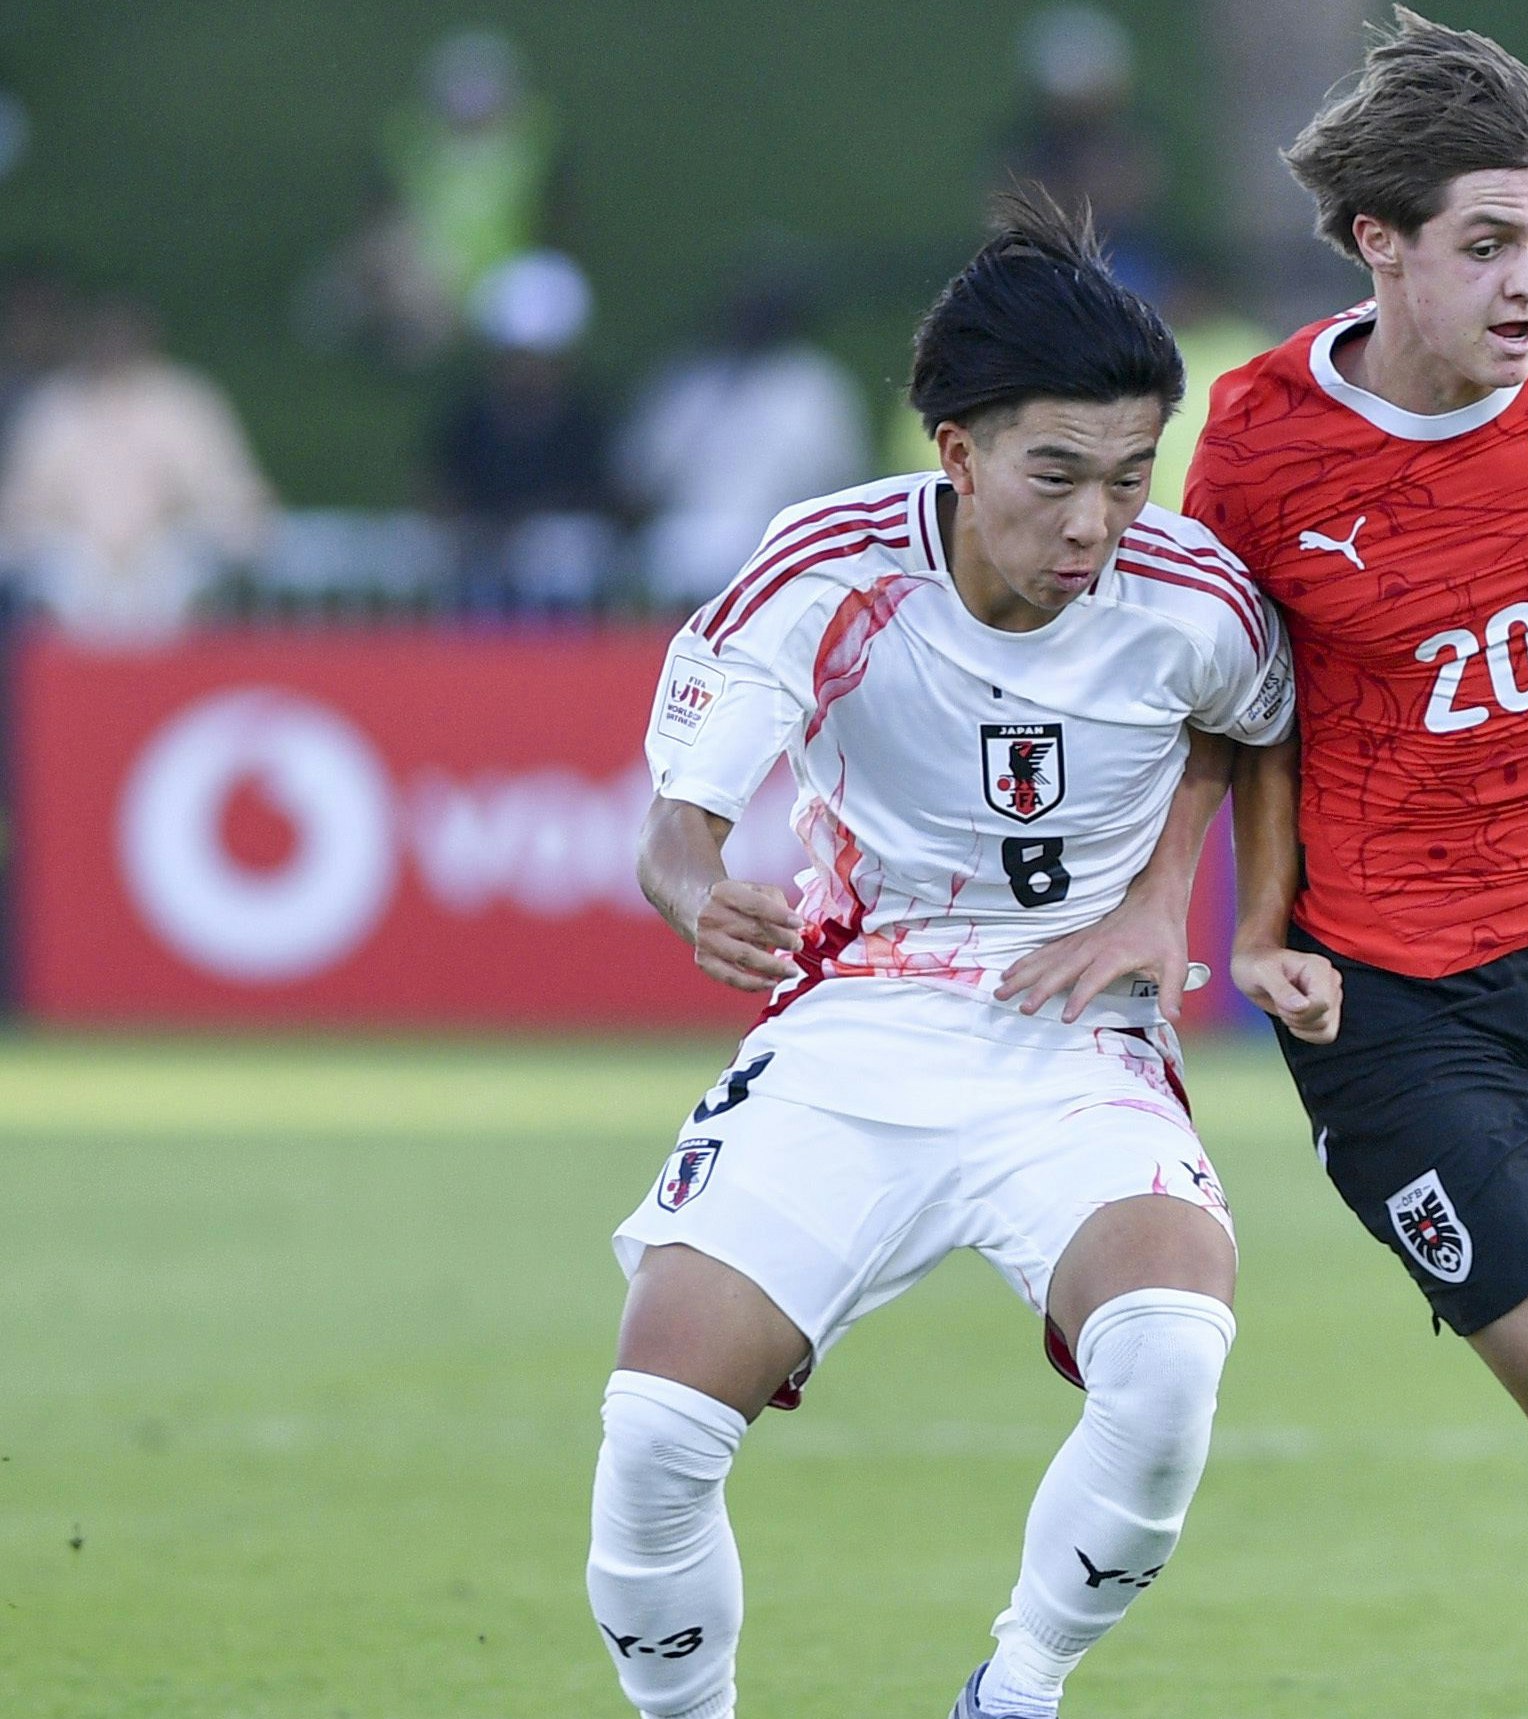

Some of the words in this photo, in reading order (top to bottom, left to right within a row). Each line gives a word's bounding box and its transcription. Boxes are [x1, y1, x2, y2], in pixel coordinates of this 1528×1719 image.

[689, 676, 706, 689] FIFA
[671, 680, 713, 711] U17
[999, 726, 1044, 736] JAPAN
[1006, 793, 1044, 808] JFA
[1001, 837, 1072, 909] 8
[599, 1622, 703, 1659] Y-3
